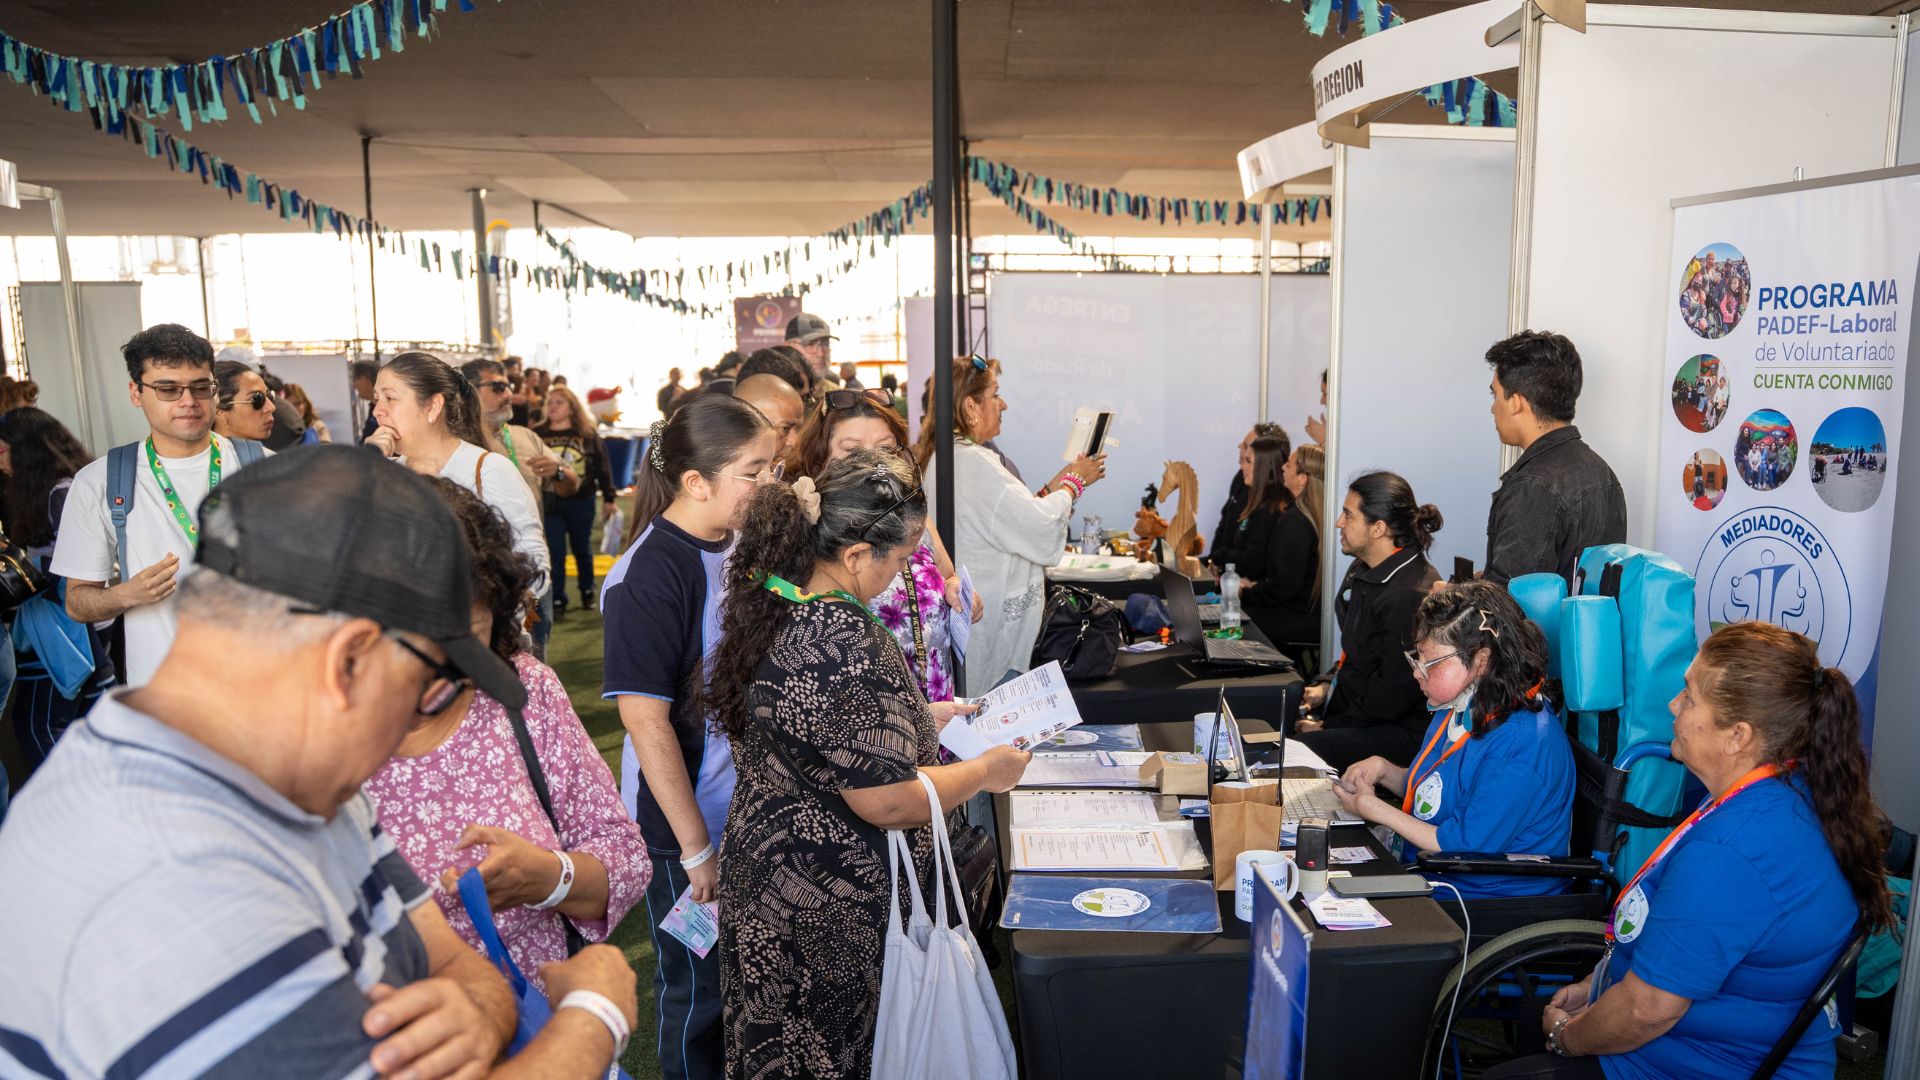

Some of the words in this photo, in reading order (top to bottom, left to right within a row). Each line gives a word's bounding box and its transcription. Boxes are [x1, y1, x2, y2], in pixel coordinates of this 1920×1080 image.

[1323, 59, 1364, 104] REGION
[1758, 279, 1898, 311] PROGRAMA
[1757, 311, 1897, 336] PADEF-Laboral
[1755, 342, 1777, 362] de
[1782, 340, 1895, 361] Voluntariado
[1753, 374, 1815, 390] CUENTA
[1818, 374, 1894, 391] CONMIGO
[1720, 515, 1823, 560] MEDIADORES
